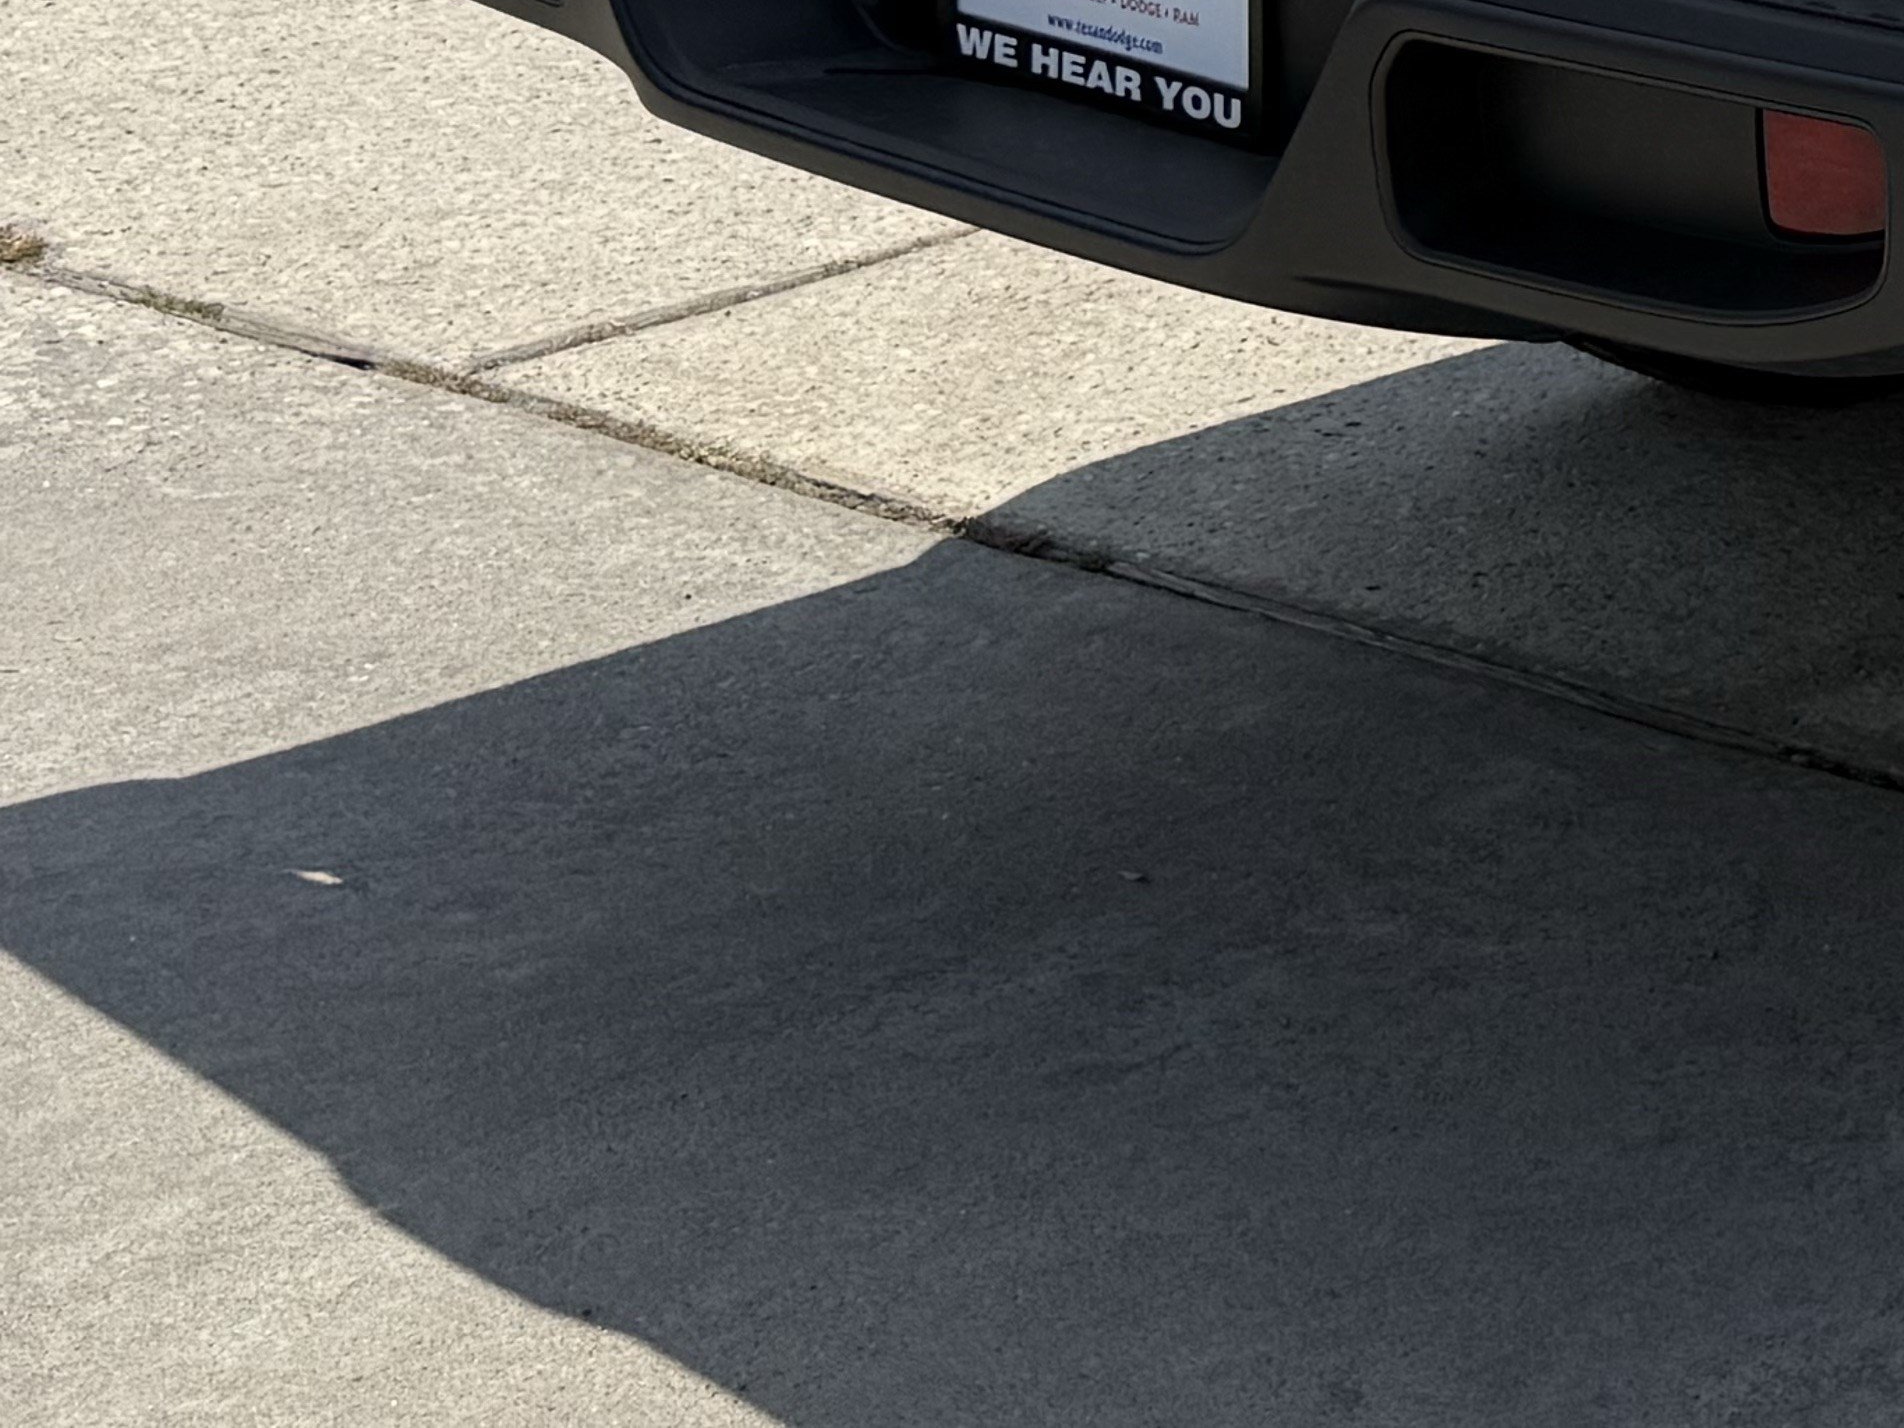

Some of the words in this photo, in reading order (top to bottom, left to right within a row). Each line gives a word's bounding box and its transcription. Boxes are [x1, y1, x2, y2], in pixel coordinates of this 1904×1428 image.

[956, 23, 1018, 70] WE
[1030, 44, 1142, 102] HEAR
[1155, 77, 1242, 131] YOU
